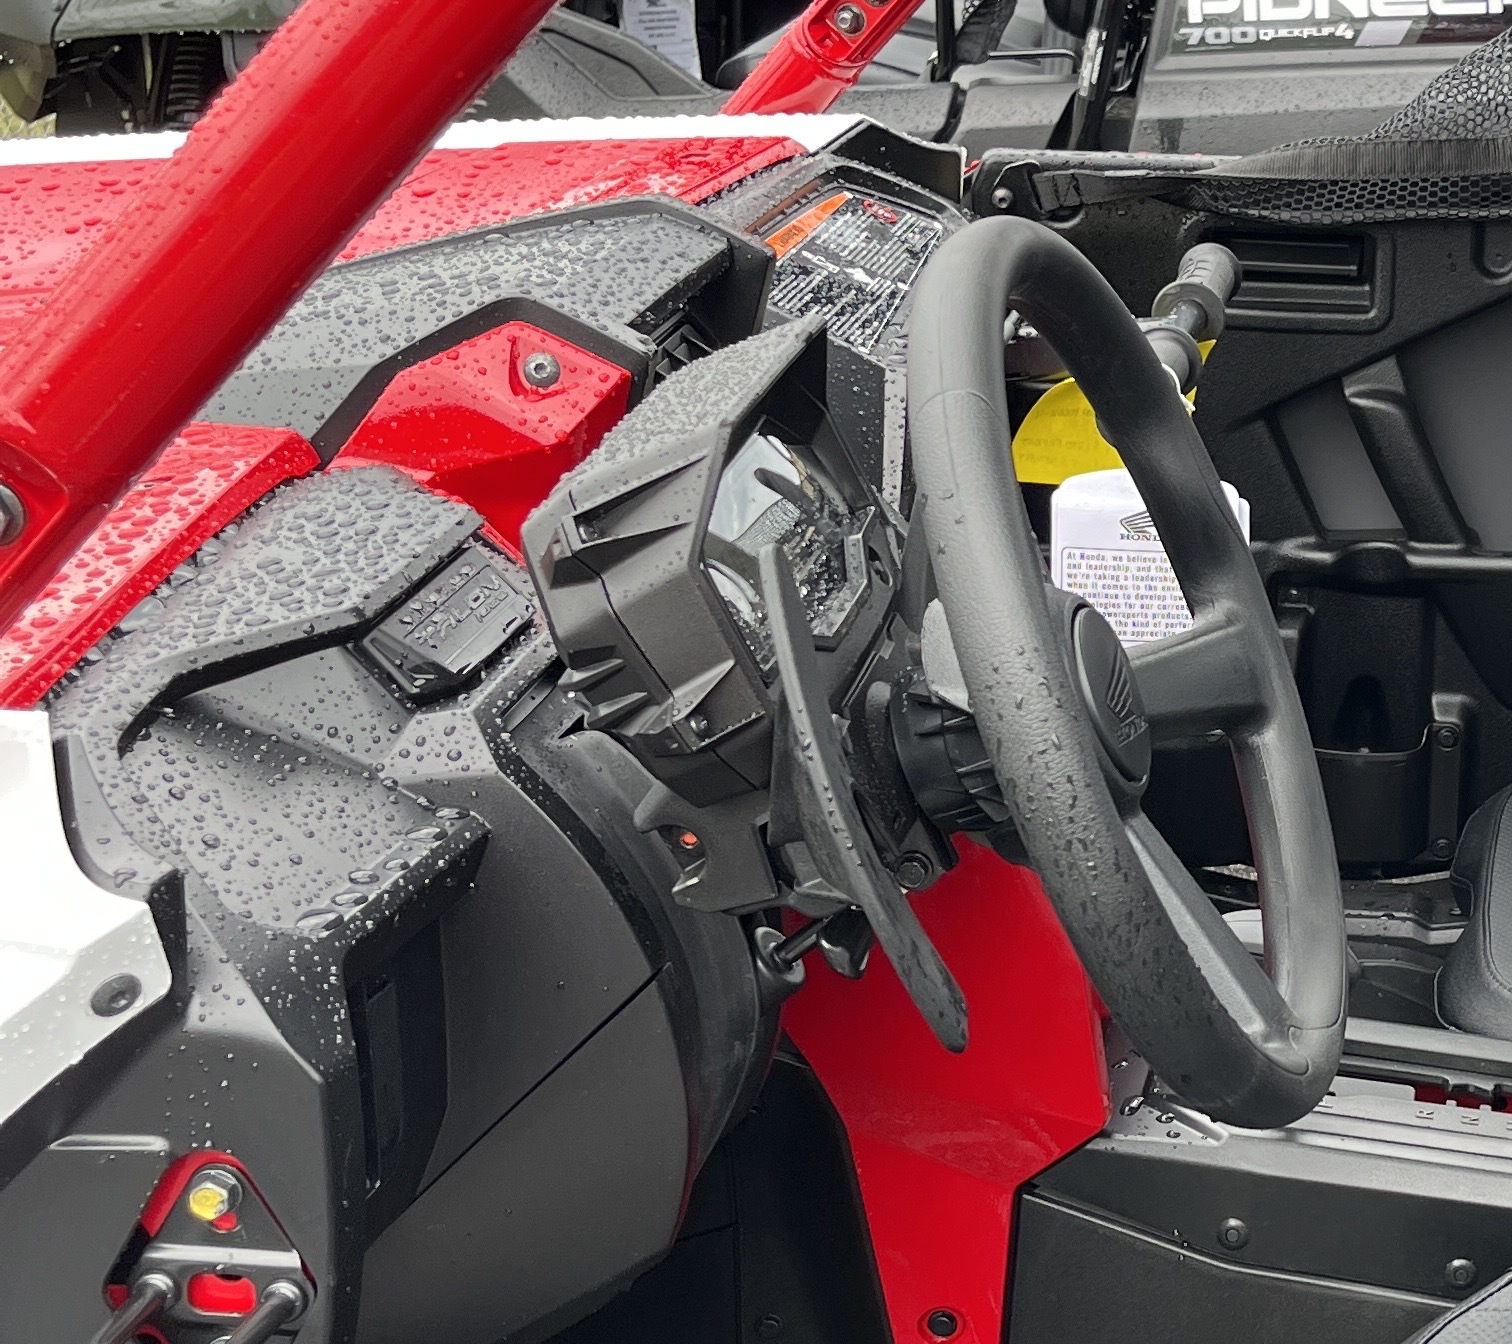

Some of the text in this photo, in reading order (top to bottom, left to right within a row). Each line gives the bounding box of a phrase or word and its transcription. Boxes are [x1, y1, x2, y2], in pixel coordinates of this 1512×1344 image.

[1177, 26, 1257, 45] 700
[1127, 555, 1157, 563] believe
[1102, 612, 1148, 620] owersports
